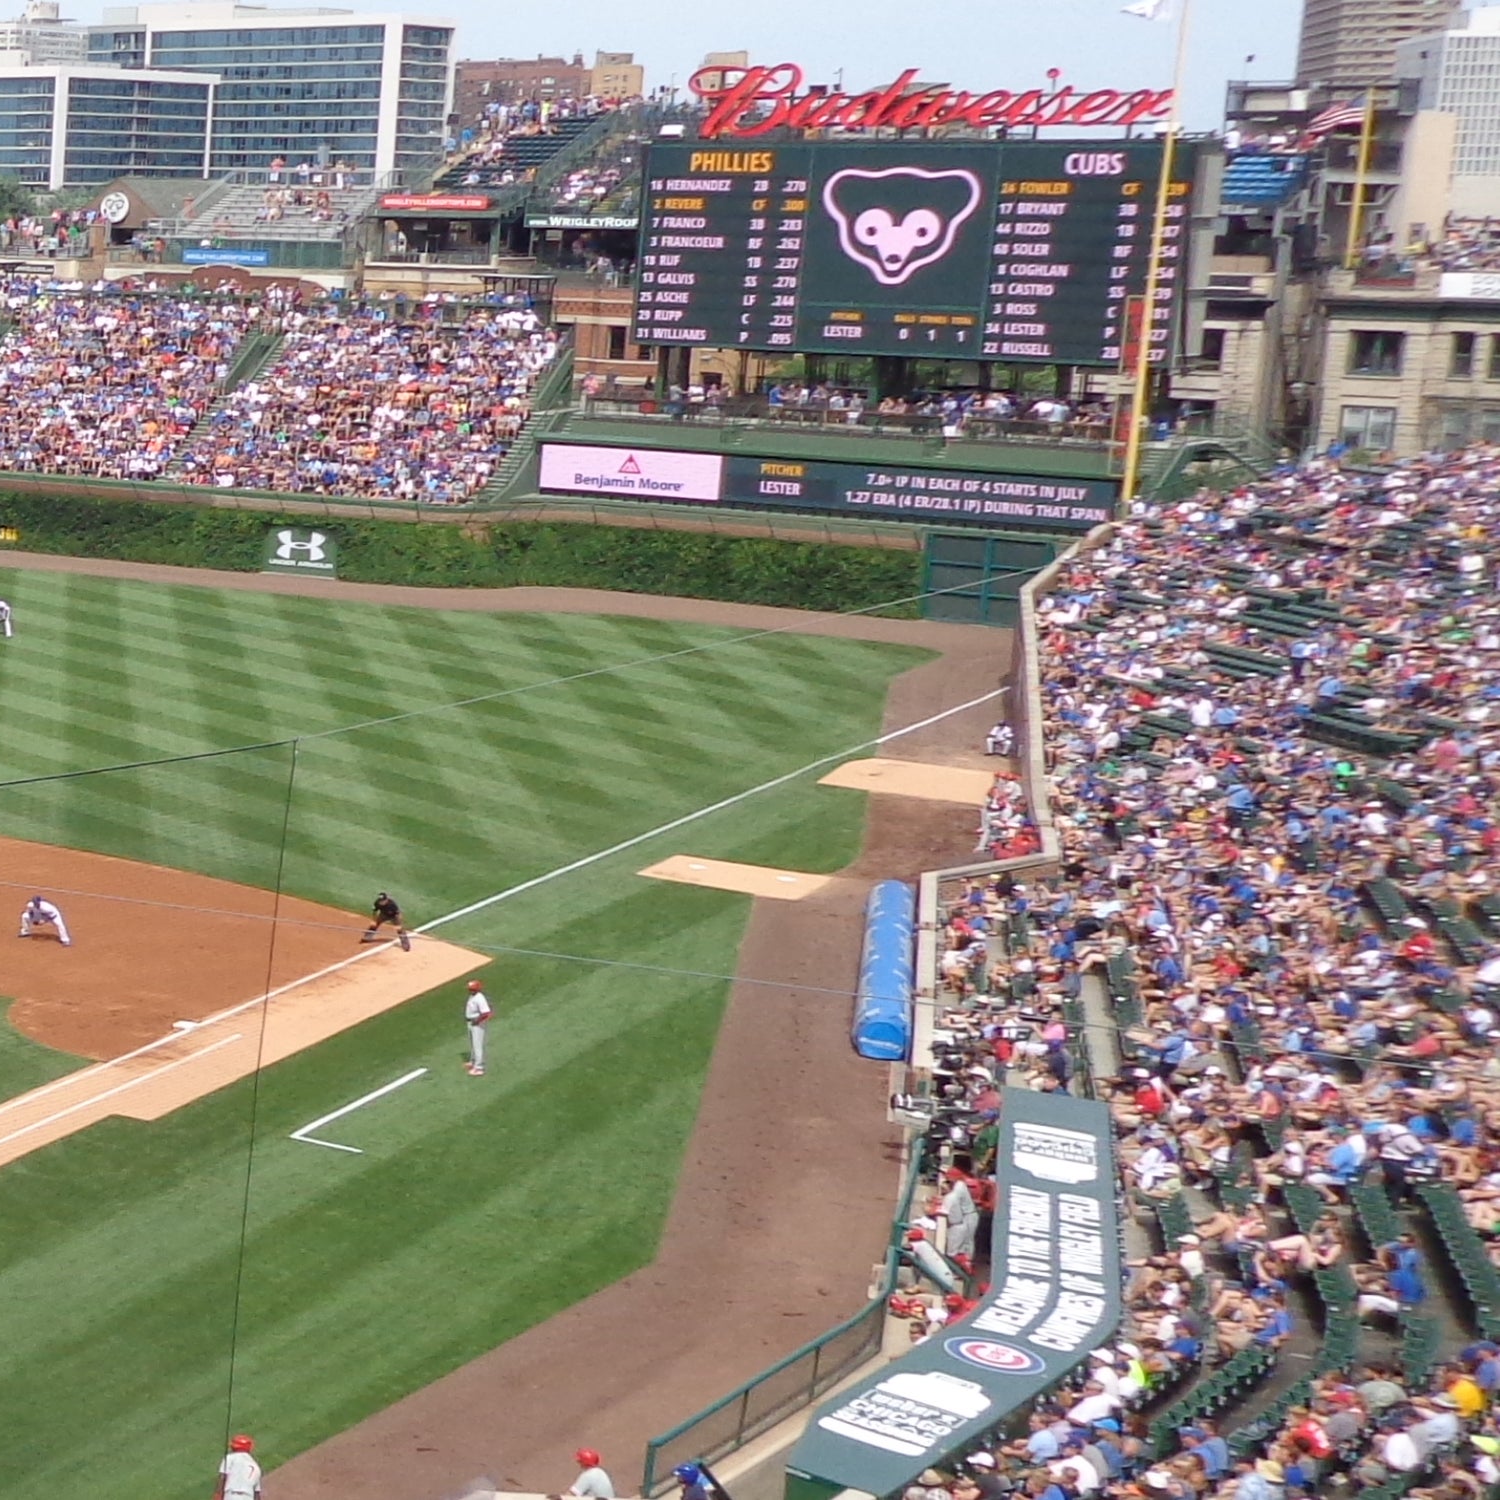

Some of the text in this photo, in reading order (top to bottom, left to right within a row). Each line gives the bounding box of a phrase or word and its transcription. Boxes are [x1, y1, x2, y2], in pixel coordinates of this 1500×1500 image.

[689, 62, 1175, 139] Budweiser
[690, 152, 772, 172] PHILLIES
[1065, 153, 1125, 174] CUBS
[666, 180, 732, 191] HERNANDEZ
[1019, 182, 1070, 194] FOWLER
[665, 198, 703, 210] REVERE
[1016, 203, 1067, 215] BRYANT
[663, 217, 705, 228] FRANCO
[1014, 223, 1050, 235] RIZZO
[661, 236, 723, 248] FRANCOEUR
[1012, 244, 1050, 255] SOLER
[660, 255, 680, 266] RUF
[1010, 264, 1069, 276] COGHLAN
[658, 273, 695, 285] GALVIS
[1008, 284, 1054, 295] CASTRO
[655, 292, 689, 303] ASCHE
[654, 310, 683, 321] RUPP
[1006, 304, 1037, 315] ROSS
[653, 328, 706, 340] WILLIAMS
[824, 326, 862, 338] LESTER
[899, 328, 965, 342] 0 1 1
[1004, 324, 1045, 335] LESTER
[1002, 343, 1051, 355] RUSSELL
[574, 473, 681, 491] Benjamin Moore
[760, 481, 800, 495] LESTER
[911, 477, 926, 488] IN
[929, 479, 961, 491] EACH
[963, 481, 980, 493] OF
[981, 482, 990, 493] 4
[993, 483, 1038, 497] STARTS
[1040, 486, 1055, 498] IN
[1056, 487, 1086, 501] JULY
[846, 491, 869, 503] 1.27
[872, 493, 896, 505] ERA
[899, 494, 911, 508] (4
[984, 501, 1033, 516] DURING
[1036, 505, 1068, 518] THAT
[1071, 508, 1107, 522] SPAN
[971, 1185, 1052, 1336] WELCOME TO THE FRIENDLY
[1028, 1193, 1106, 1352] CONFINES OF WRIGLEY FIELD
[849, 1398, 952, 1436] CHICAGO
